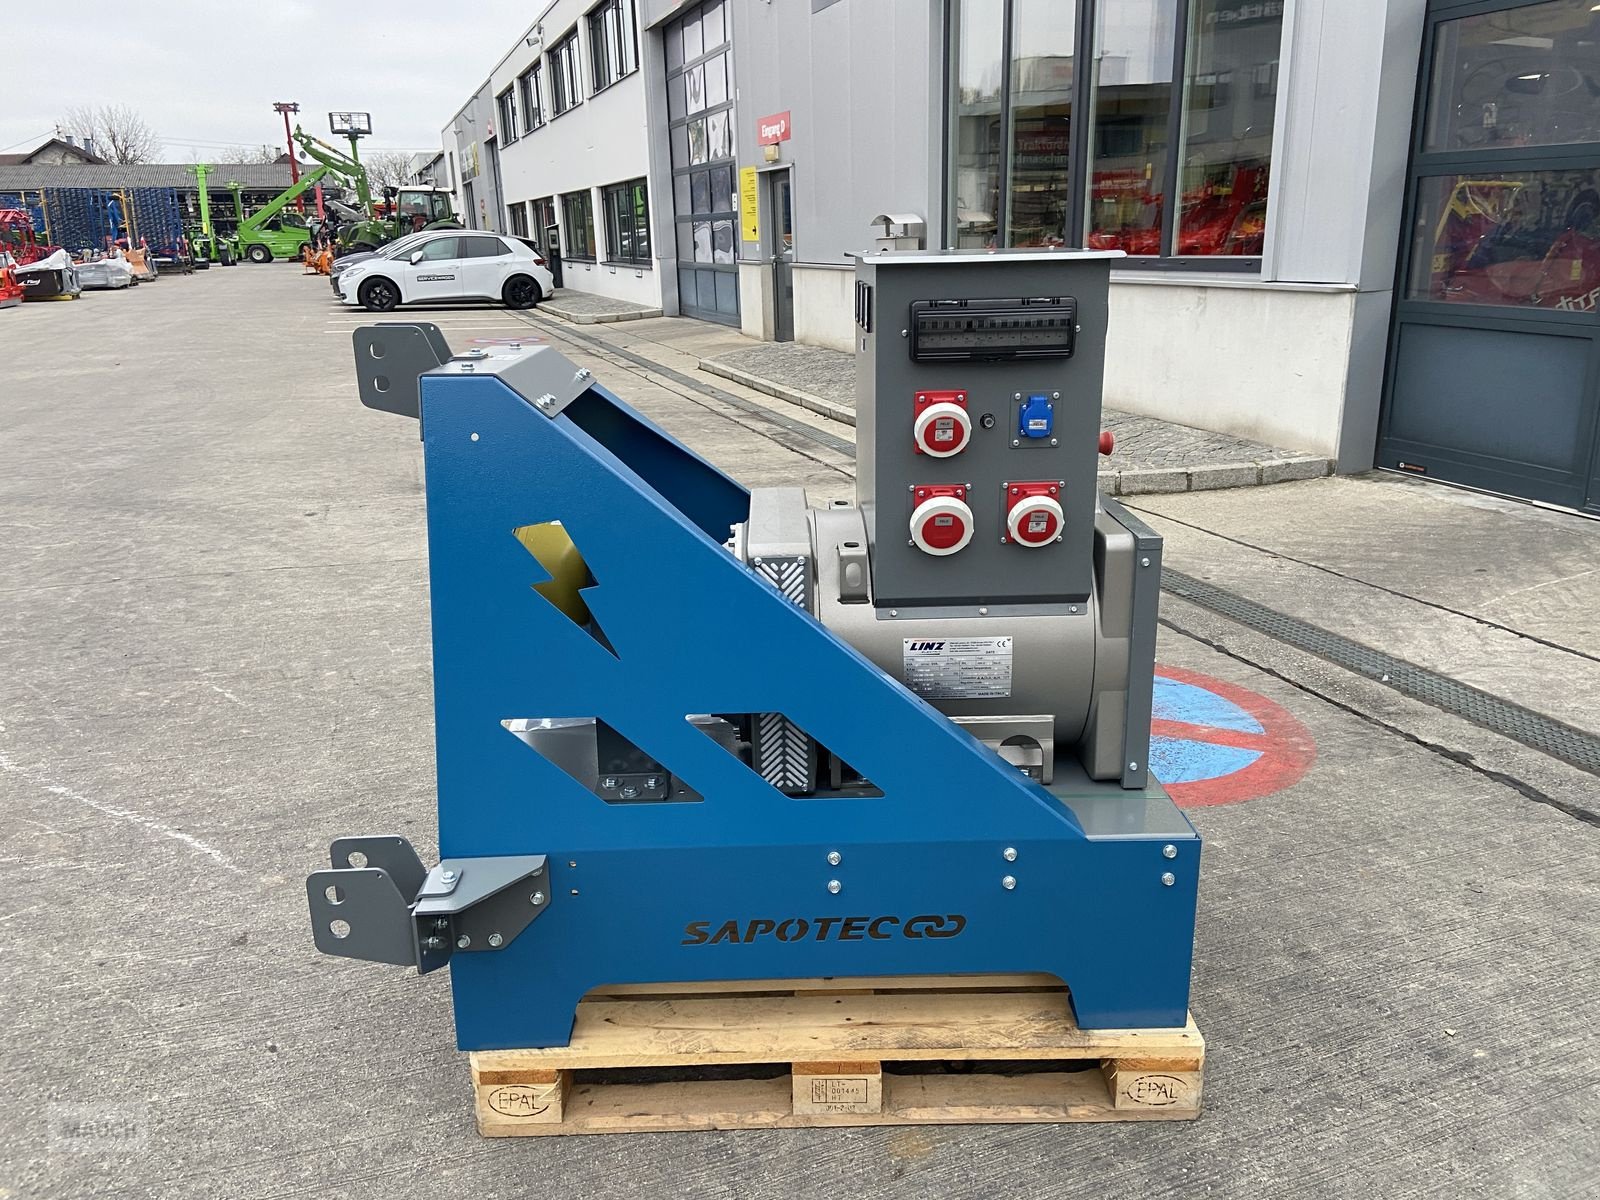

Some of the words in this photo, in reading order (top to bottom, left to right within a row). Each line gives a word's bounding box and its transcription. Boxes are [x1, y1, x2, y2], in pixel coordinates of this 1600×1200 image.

[780, 119, 786, 134] D
[909, 641, 946, 651] LINZ
[680, 916, 900, 946] SAPOTEC
[1137, 1082, 1178, 1099] EPAL
[498, 1092, 540, 1110] EPAL
